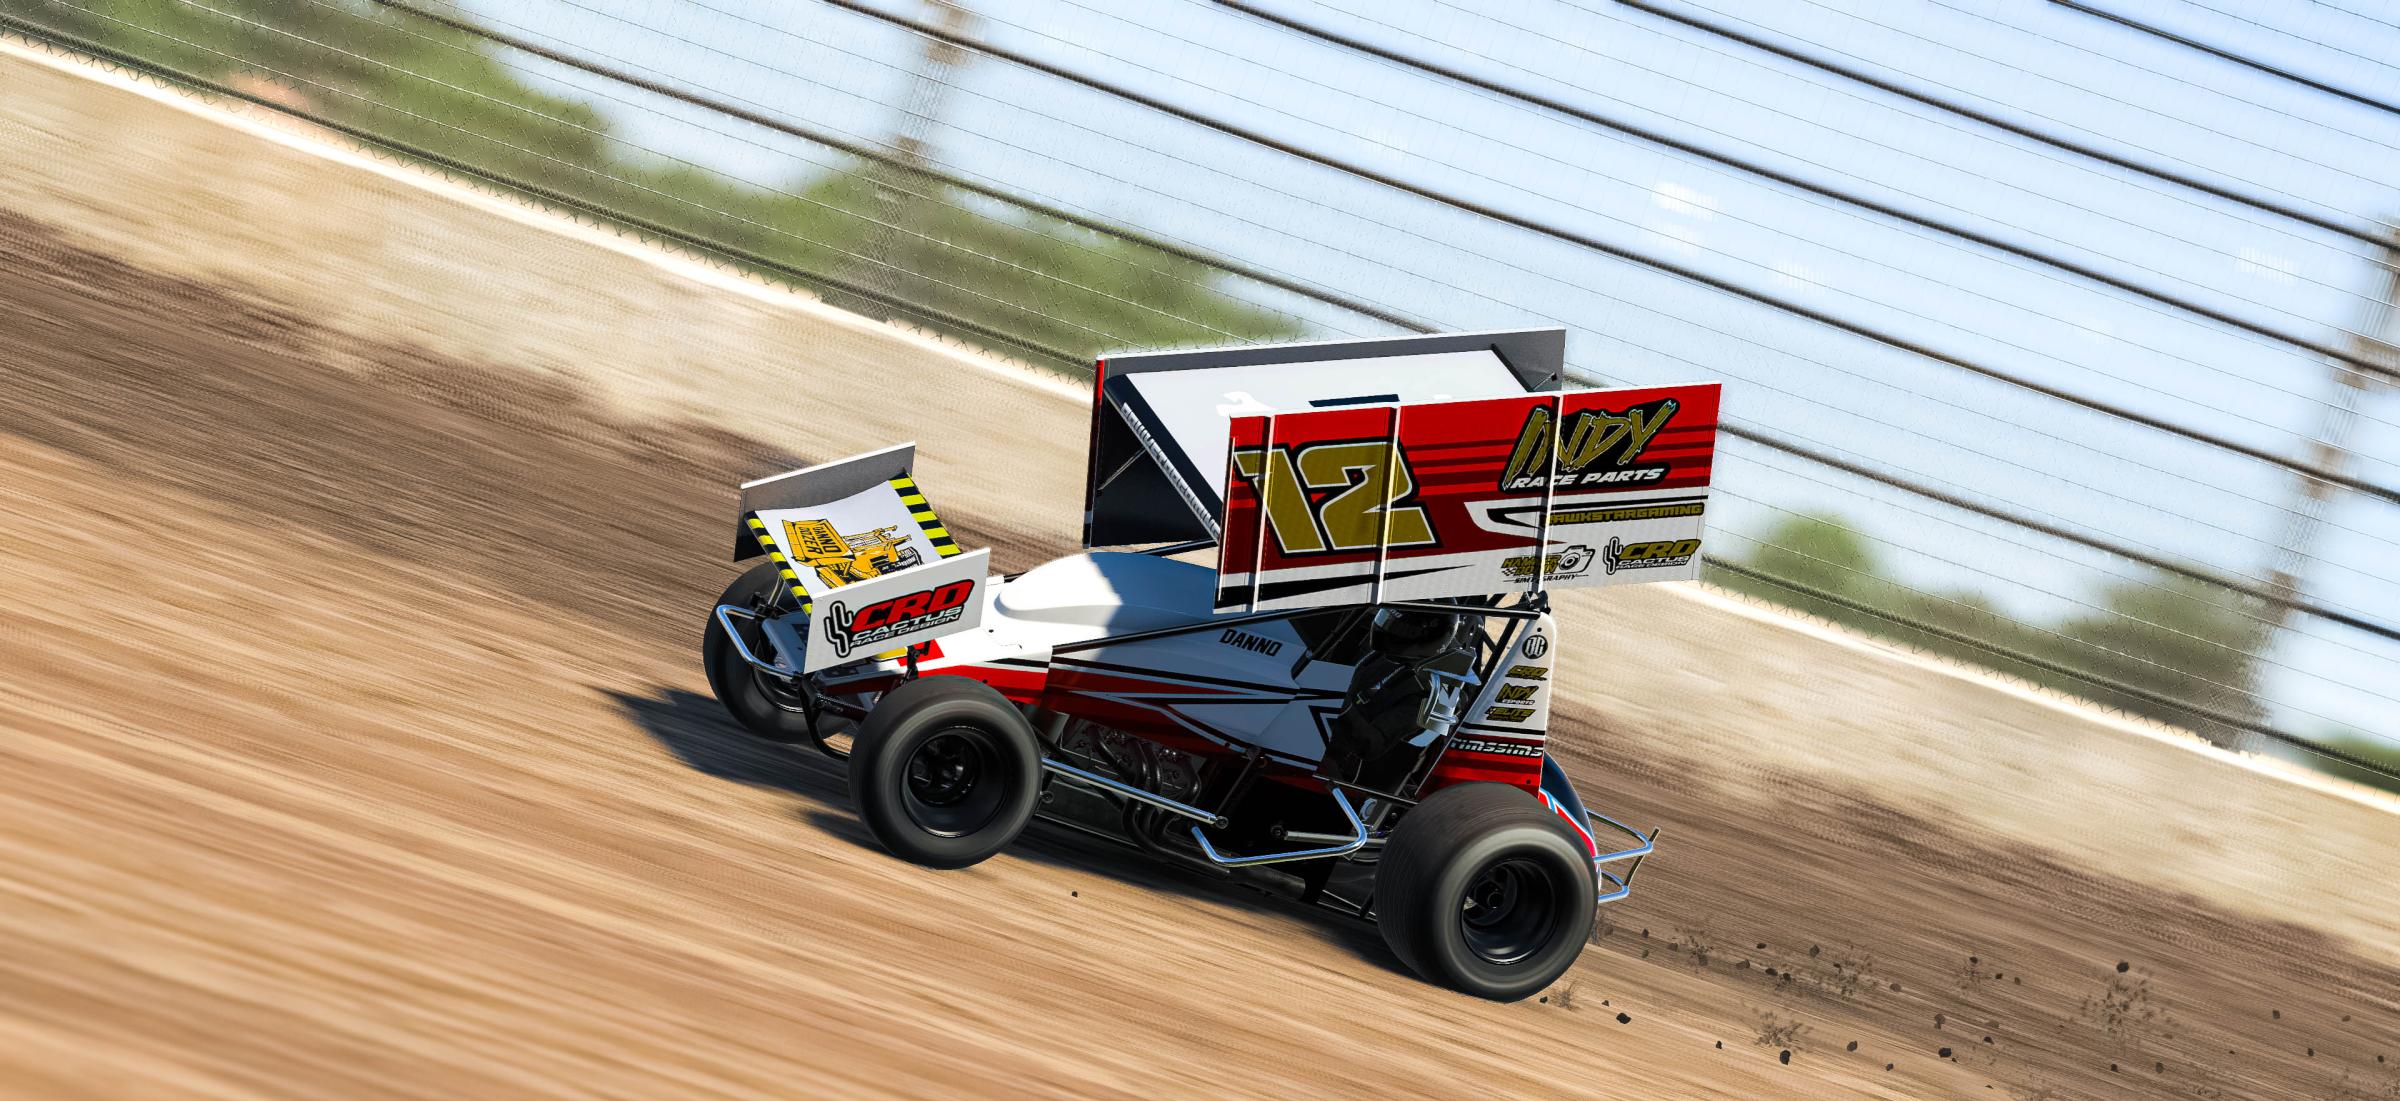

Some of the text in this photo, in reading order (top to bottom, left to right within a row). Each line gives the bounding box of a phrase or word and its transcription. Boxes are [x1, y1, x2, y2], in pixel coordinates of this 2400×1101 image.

[1502, 401, 1677, 490] INDY
[1580, 468, 1665, 484] PARTS
[1233, 441, 1436, 554] 12
[812, 526, 843, 553] DANNO
[1619, 539, 1701, 561] CRD
[1514, 563, 1557, 575] DON
[851, 579, 975, 632] CRD
[850, 614, 960, 648] RACE DESIGN
[852, 606, 963, 641] CACTUS
[1219, 628, 1283, 656] DANNO
